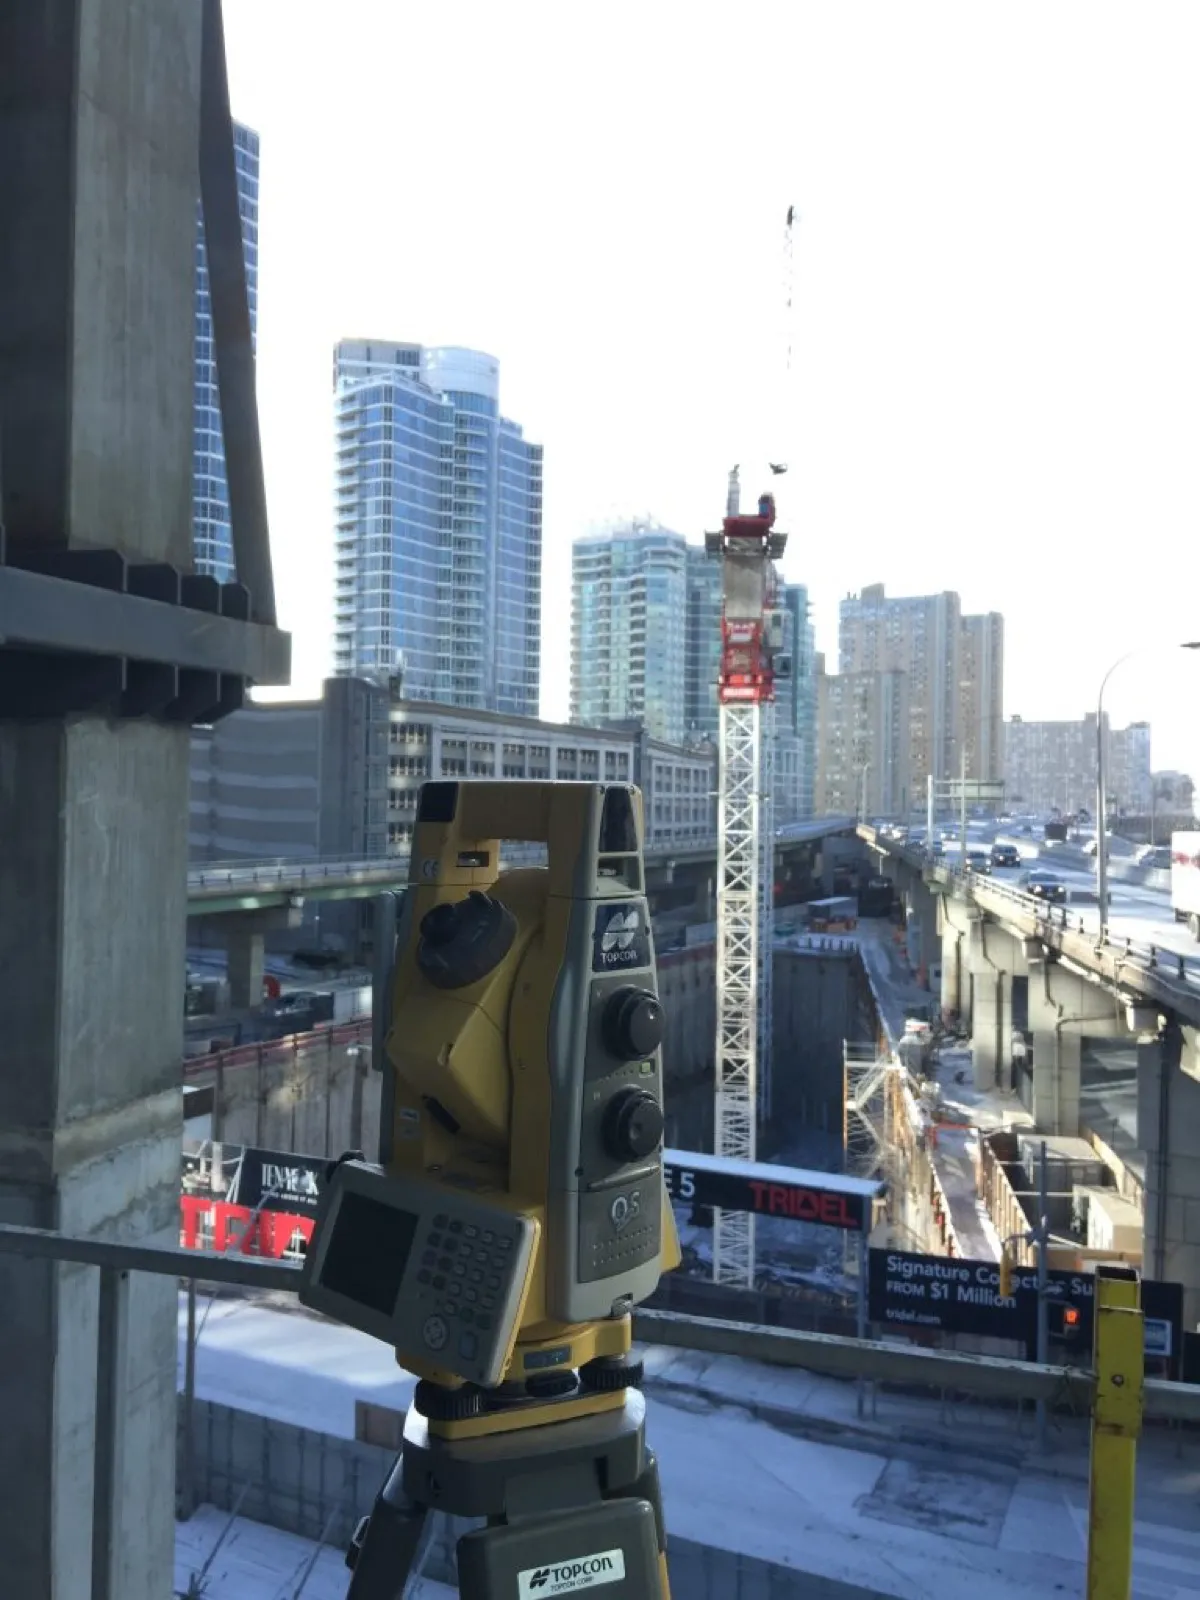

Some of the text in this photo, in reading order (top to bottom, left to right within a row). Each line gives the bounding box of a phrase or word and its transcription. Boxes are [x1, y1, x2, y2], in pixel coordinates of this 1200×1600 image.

[679, 1171, 696, 1198] 5
[749, 1181, 858, 1226] TRIDEL
[886, 1255, 971, 1282] Signature
[886, 1280, 1018, 1309] FROM $1 Million
